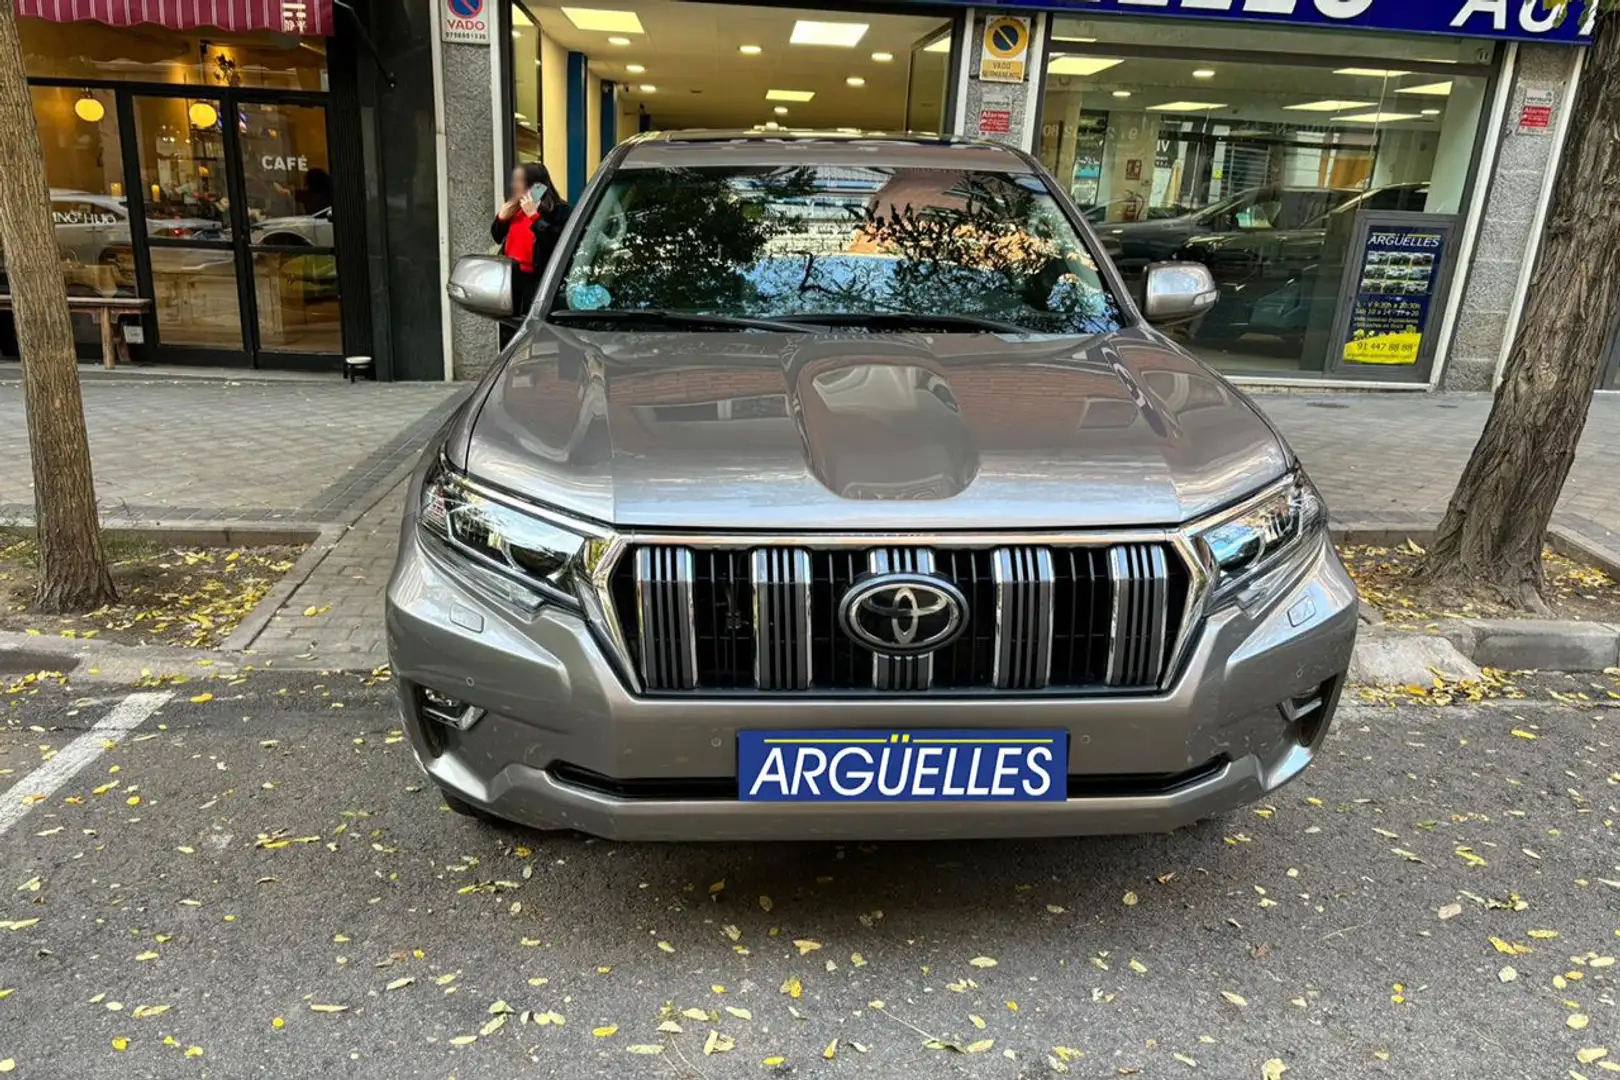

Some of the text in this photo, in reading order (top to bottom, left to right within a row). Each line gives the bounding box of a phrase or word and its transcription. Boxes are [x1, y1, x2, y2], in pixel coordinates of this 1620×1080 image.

[446, 20, 485, 30] VADO
[262, 154, 308, 171] CAFÉ
[749, 734, 1053, 796] ARGÜELLES
